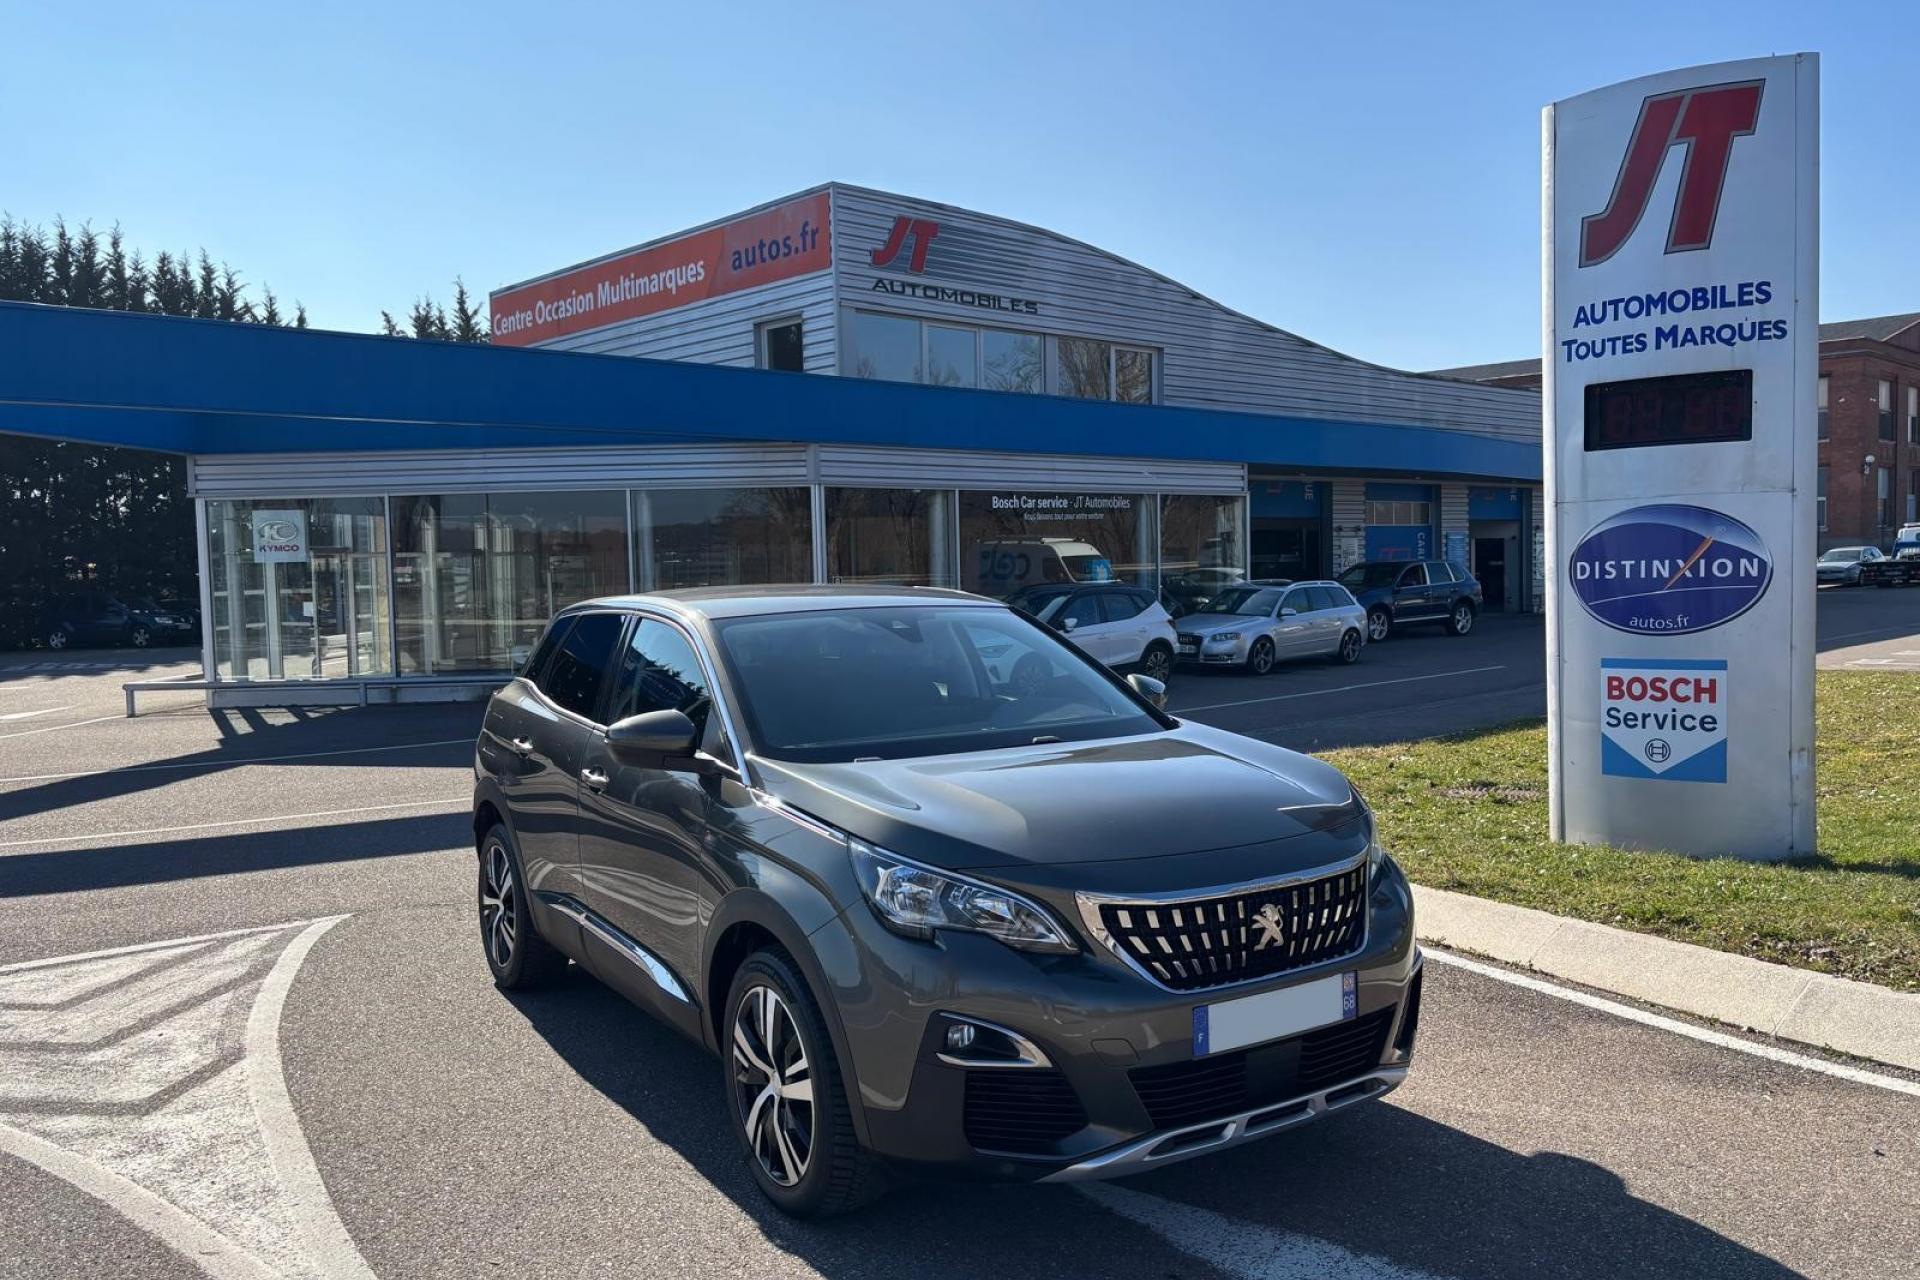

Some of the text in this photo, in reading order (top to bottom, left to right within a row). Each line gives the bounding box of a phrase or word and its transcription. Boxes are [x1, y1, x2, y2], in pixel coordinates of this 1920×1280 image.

[1578, 78, 1766, 268] JT
[731, 220, 820, 272] autos.fr
[869, 215, 940, 273] JT
[493, 259, 705, 336] Centre Occasion Multimarques
[872, 278, 1038, 314] AUTOMOBILES
[1573, 280, 1772, 328] AUTOMOBILES
[992, 494, 1019, 508] Bosch
[1021, 495, 1036, 508] Car
[1038, 495, 1068, 508] service
[1073, 495, 1084, 508] JT
[1085, 495, 1130, 508] Automobiles
[259, 544, 300, 552] KYMCO
[1576, 557, 1760, 580] DISTINXION
[1629, 614, 1690, 629] autos.fr
[1606, 675, 1718, 704] BOSCH
[1605, 706, 1718, 732] Service
[1343, 994, 1355, 1010] 68
[1198, 1033, 1205, 1043] F
